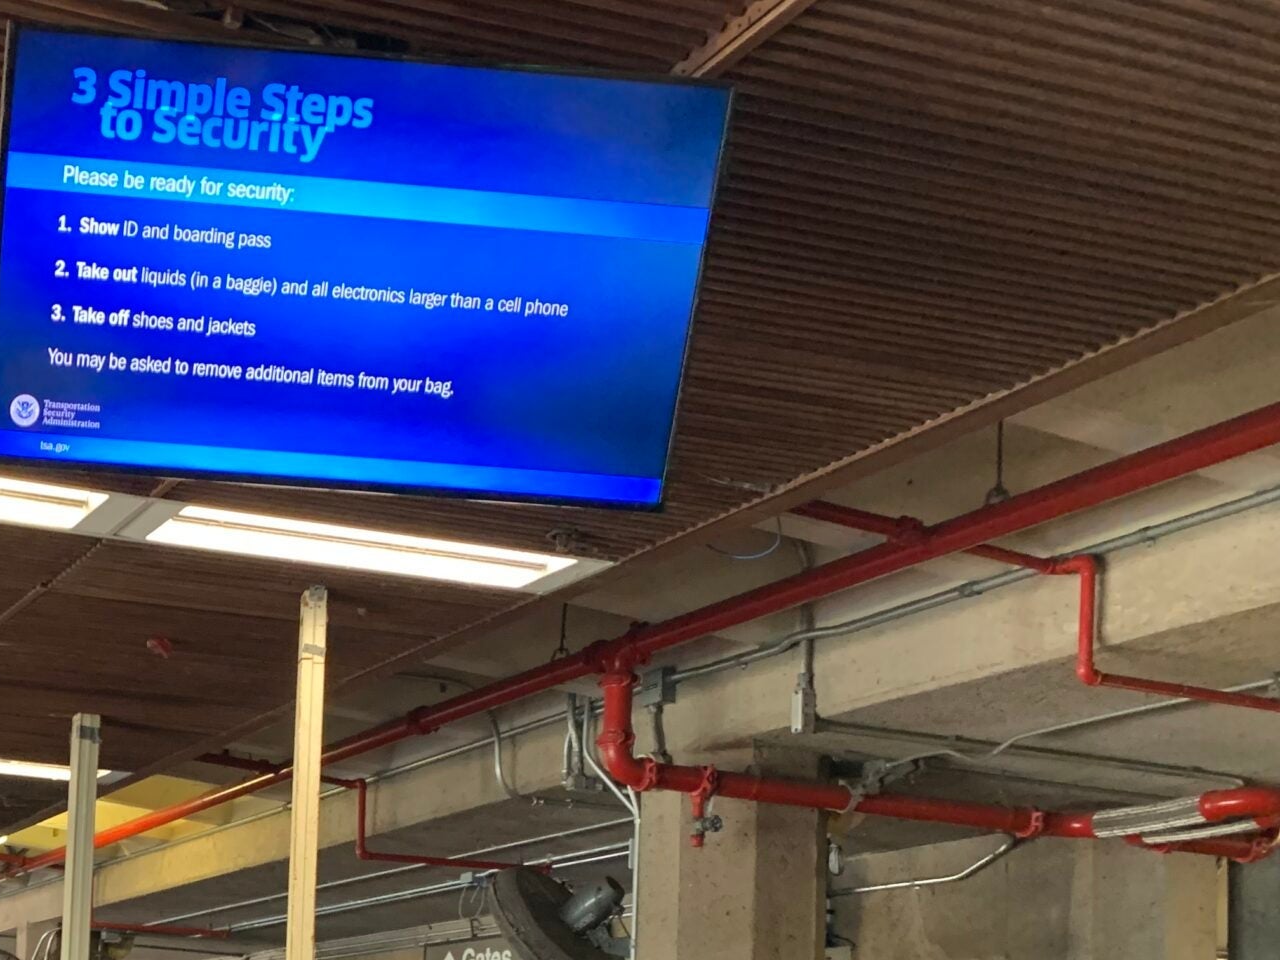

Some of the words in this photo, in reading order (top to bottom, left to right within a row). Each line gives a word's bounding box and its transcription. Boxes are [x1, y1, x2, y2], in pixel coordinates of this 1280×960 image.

[72, 67, 96, 103] 3
[108, 69, 250, 118] Simple
[260, 83, 374, 132] Steps
[100, 101, 142, 140] to
[152, 105, 329, 162] Security
[63, 165, 118, 188] Please
[124, 170, 144, 189] be
[150, 175, 195, 198] ready
[200, 176, 223, 196] for
[227, 181, 295, 205] security:
[58, 215, 72, 232] 1.
[79, 217, 120, 235] Show
[123, 220, 138, 237] ID
[142, 223, 169, 240] and
[173, 224, 235, 248] boarding
[238, 232, 271, 249] pass
[54, 259, 69, 277] 2.
[76, 261, 109, 280] Take
[112, 265, 138, 282] out
[141, 266, 186, 287] liquids
[190, 270, 208, 290] (in
[212, 275, 222, 288] a
[225, 273, 278, 296] baggie)
[281, 279, 308, 296] and
[312, 281, 328, 298] all
[332, 283, 405, 303] electronics
[409, 288, 447, 309] larger
[450, 292, 481, 310] than
[485, 297, 494, 311] a
[498, 297, 521, 313] cell
[524, 299, 569, 317] phone
[51, 304, 66, 322] 3.
[72, 305, 105, 324] Take
[108, 309, 131, 326] off
[132, 311, 173, 330] shoes
[177, 315, 204, 332] and
[206, 317, 256, 337] jackets
[48, 347, 72, 366] You
[76, 355, 105, 373] may
[109, 352, 127, 370] be
[130, 356, 171, 374] asked
[174, 359, 189, 375] to
[192, 362, 242, 380] remove
[245, 364, 313, 385] additional
[317, 368, 355, 389] items
[358, 372, 389, 390] from
[391, 377, 422, 395] your
[424, 377, 454, 399] bag.
[42, 408, 75, 420] Security
[43, 399, 100, 412] Transportation
[42, 417, 100, 429] Administration
[40, 441, 71, 453] tsa.gov
